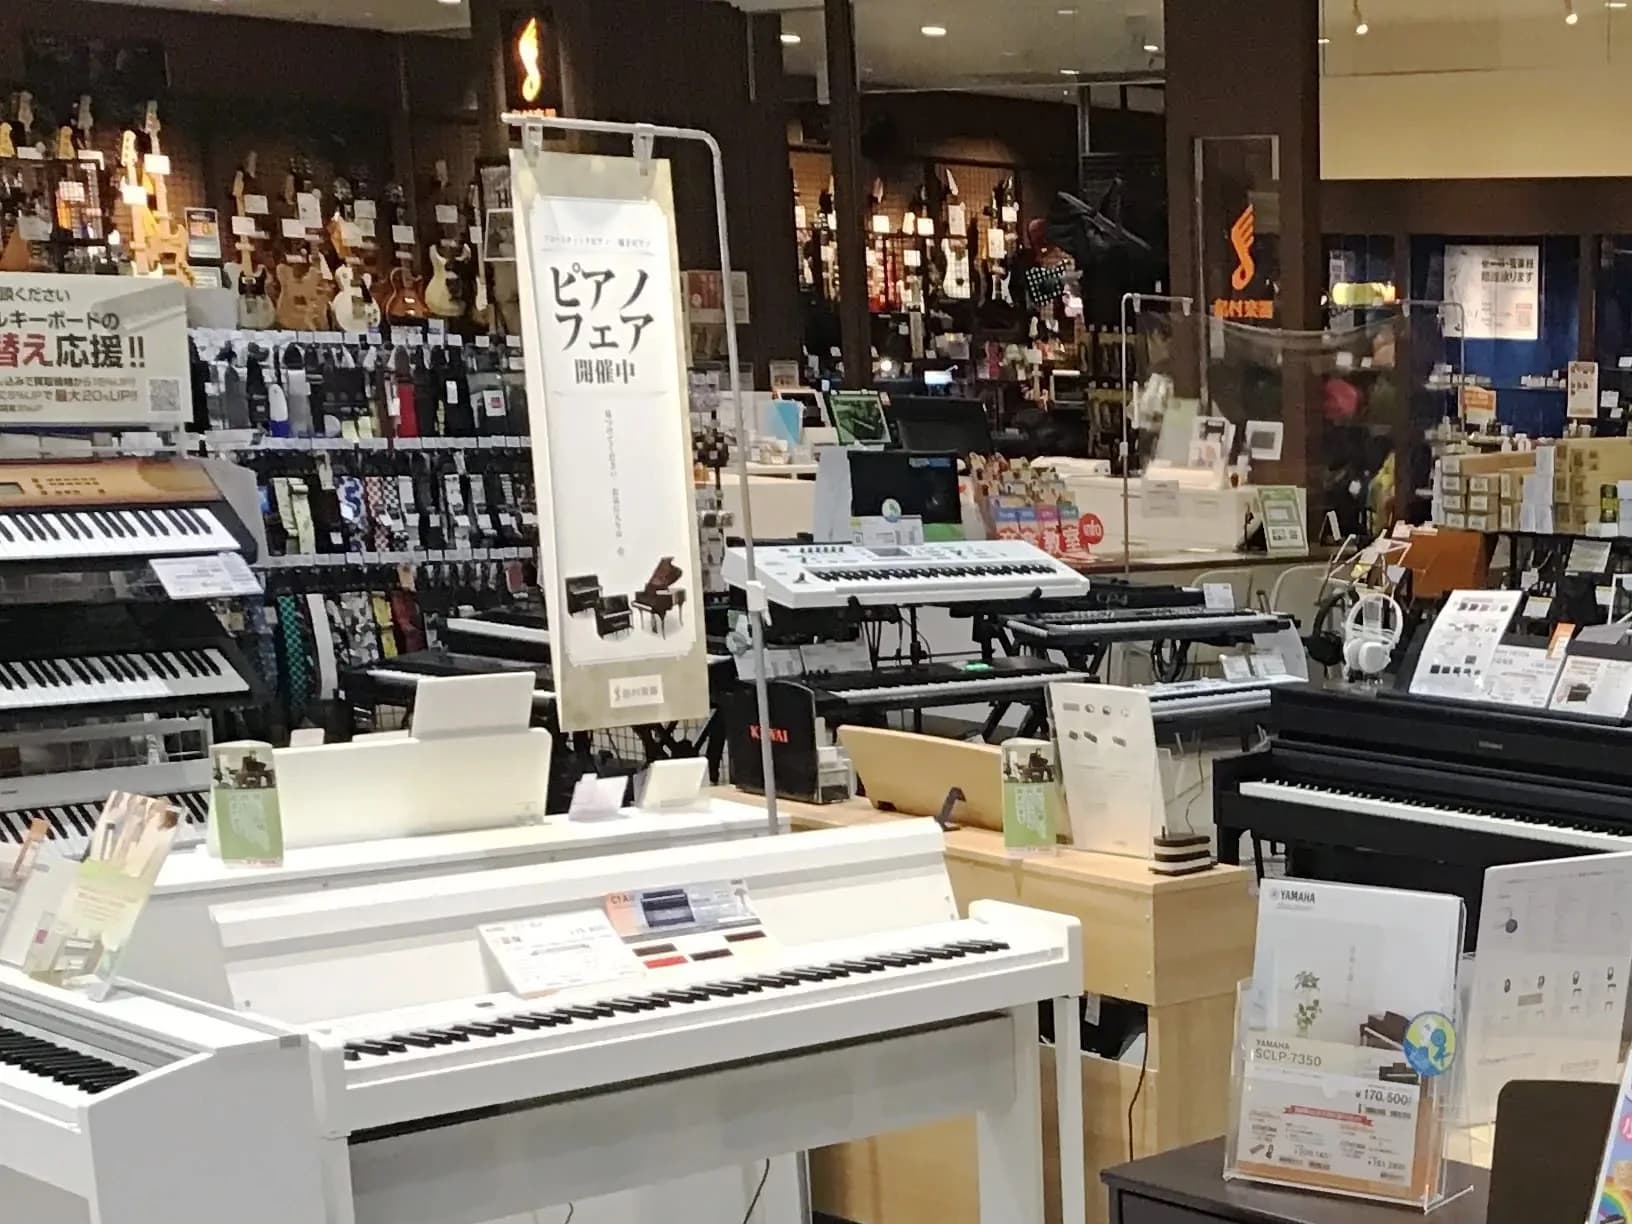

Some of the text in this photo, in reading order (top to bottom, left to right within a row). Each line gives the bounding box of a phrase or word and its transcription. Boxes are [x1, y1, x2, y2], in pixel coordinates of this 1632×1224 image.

[549, 261, 649, 312] ピアノ
[555, 313, 655, 354] フェア
[574, 358, 636, 384] 開催中
[1279, 888, 1316, 904] YAMAHA
[1256, 1039, 1291, 1050] YAMAHA
[1254, 1048, 1322, 1068] SCLP-7350
